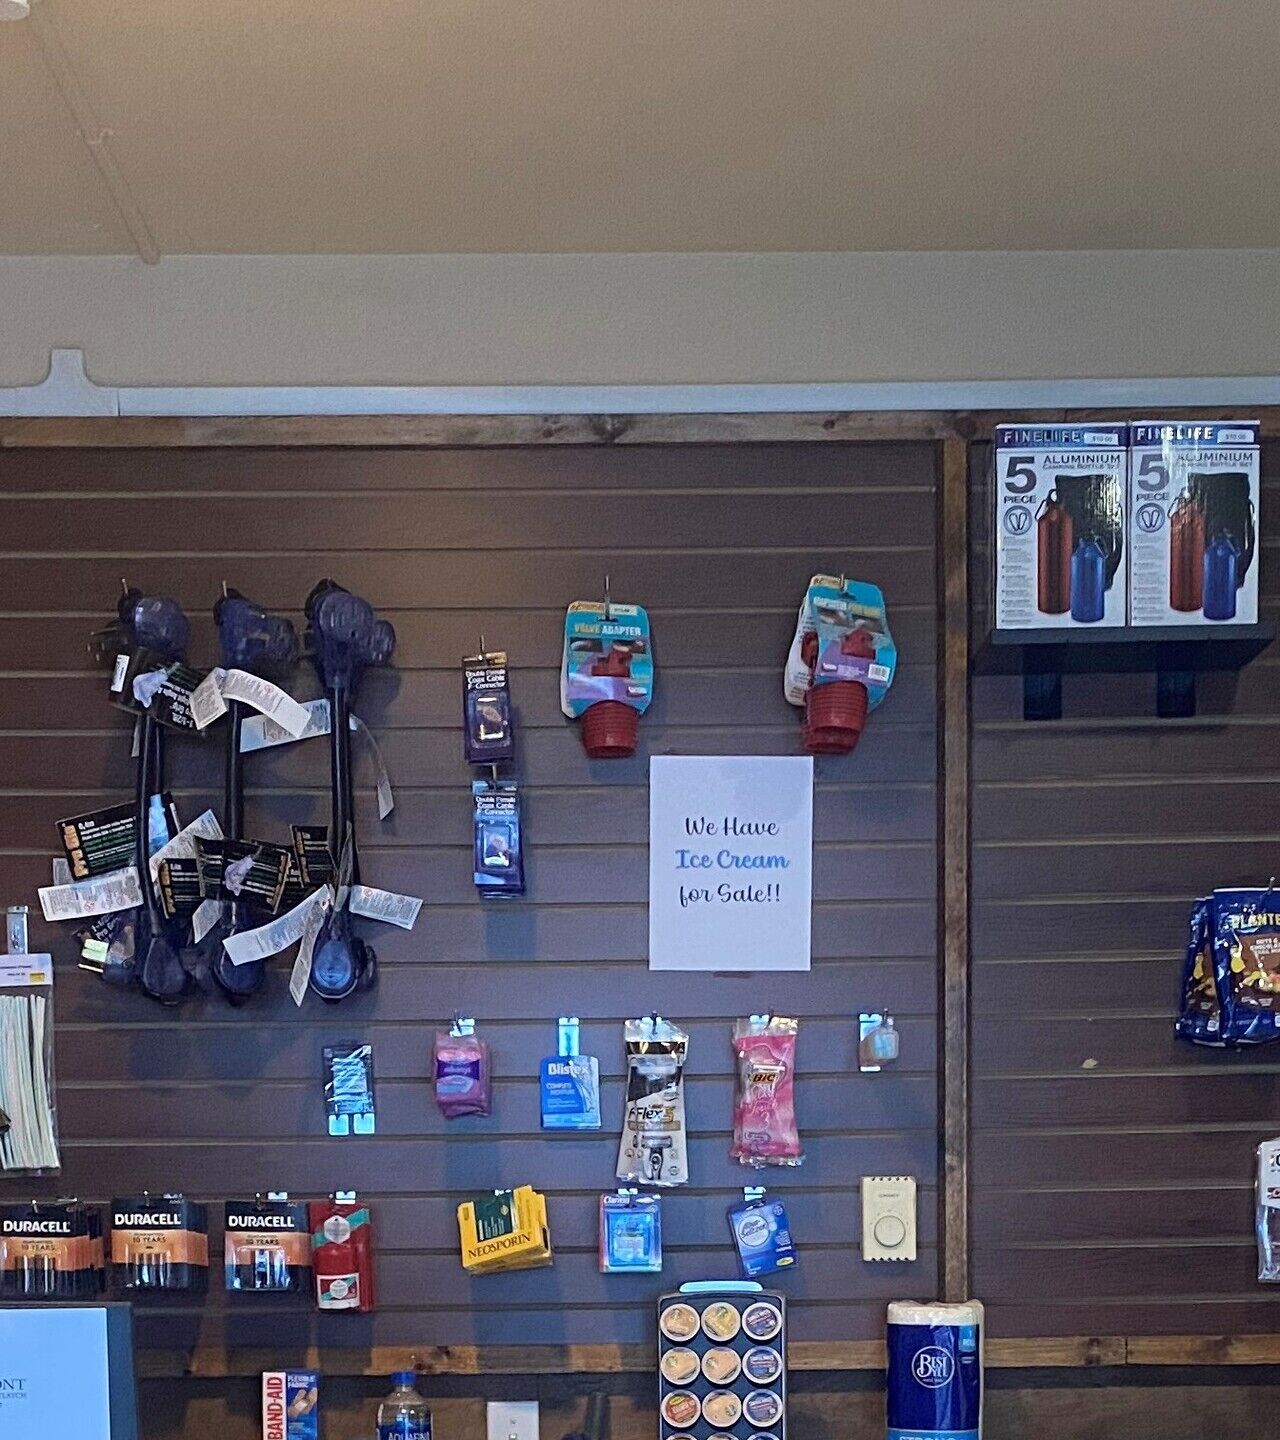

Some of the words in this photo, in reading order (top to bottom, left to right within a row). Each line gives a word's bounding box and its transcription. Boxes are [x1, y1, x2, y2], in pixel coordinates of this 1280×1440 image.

[1004, 429, 1081, 443] FINELIFE
[1137, 426, 1213, 441] FINELIFE
[1044, 454, 1120, 464] ALUMINIUM
[1177, 453, 1253, 462] ALUMINIUM
[1005, 456, 1037, 494] 5
[1137, 454, 1169, 492] 5
[1004, 495, 1037, 504] PIECE
[1136, 493, 1169, 501] PIECE
[602, 625, 642, 636] ADAPTER
[685, 816, 718, 836] We
[723, 816, 780, 836] Have
[675, 848, 713, 869] Ice
[717, 849, 790, 869] Cream
[679, 884, 714, 907] for
[717, 883, 780, 902] Sale!!
[752, 1073, 777, 1083] BIC
[637, 1107, 663, 1120] Flex
[114, 1213, 181, 1226] DURACELL
[228, 1215, 295, 1228] DURACELL
[3, 1220, 71, 1233] DURACELL
[468, 1232, 532, 1259] NEOSPORIN
[267, 1376, 283, 1440] BAND-AID
